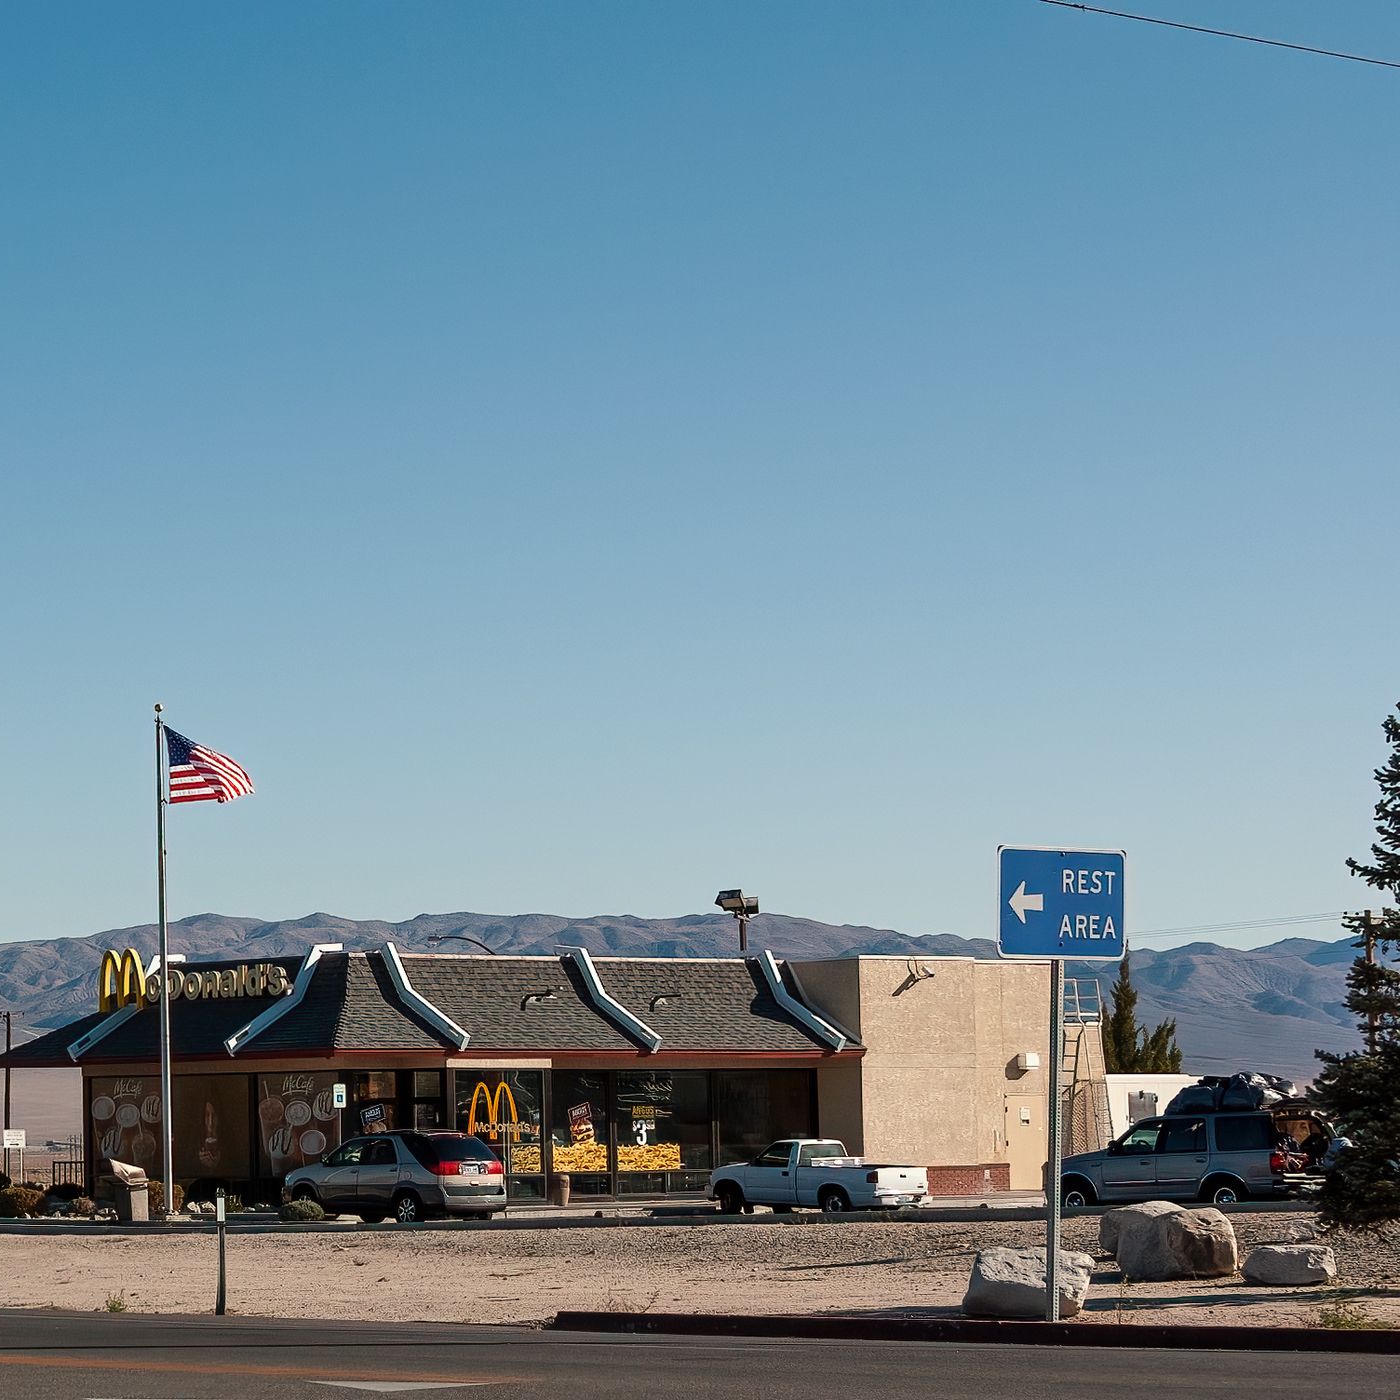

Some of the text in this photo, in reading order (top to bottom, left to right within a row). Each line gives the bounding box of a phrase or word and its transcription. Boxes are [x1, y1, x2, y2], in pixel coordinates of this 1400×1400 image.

[1062, 868, 1116, 895] REST
[1059, 914, 1117, 939] AREA
[474, 1120, 531, 1134] McDonald's
